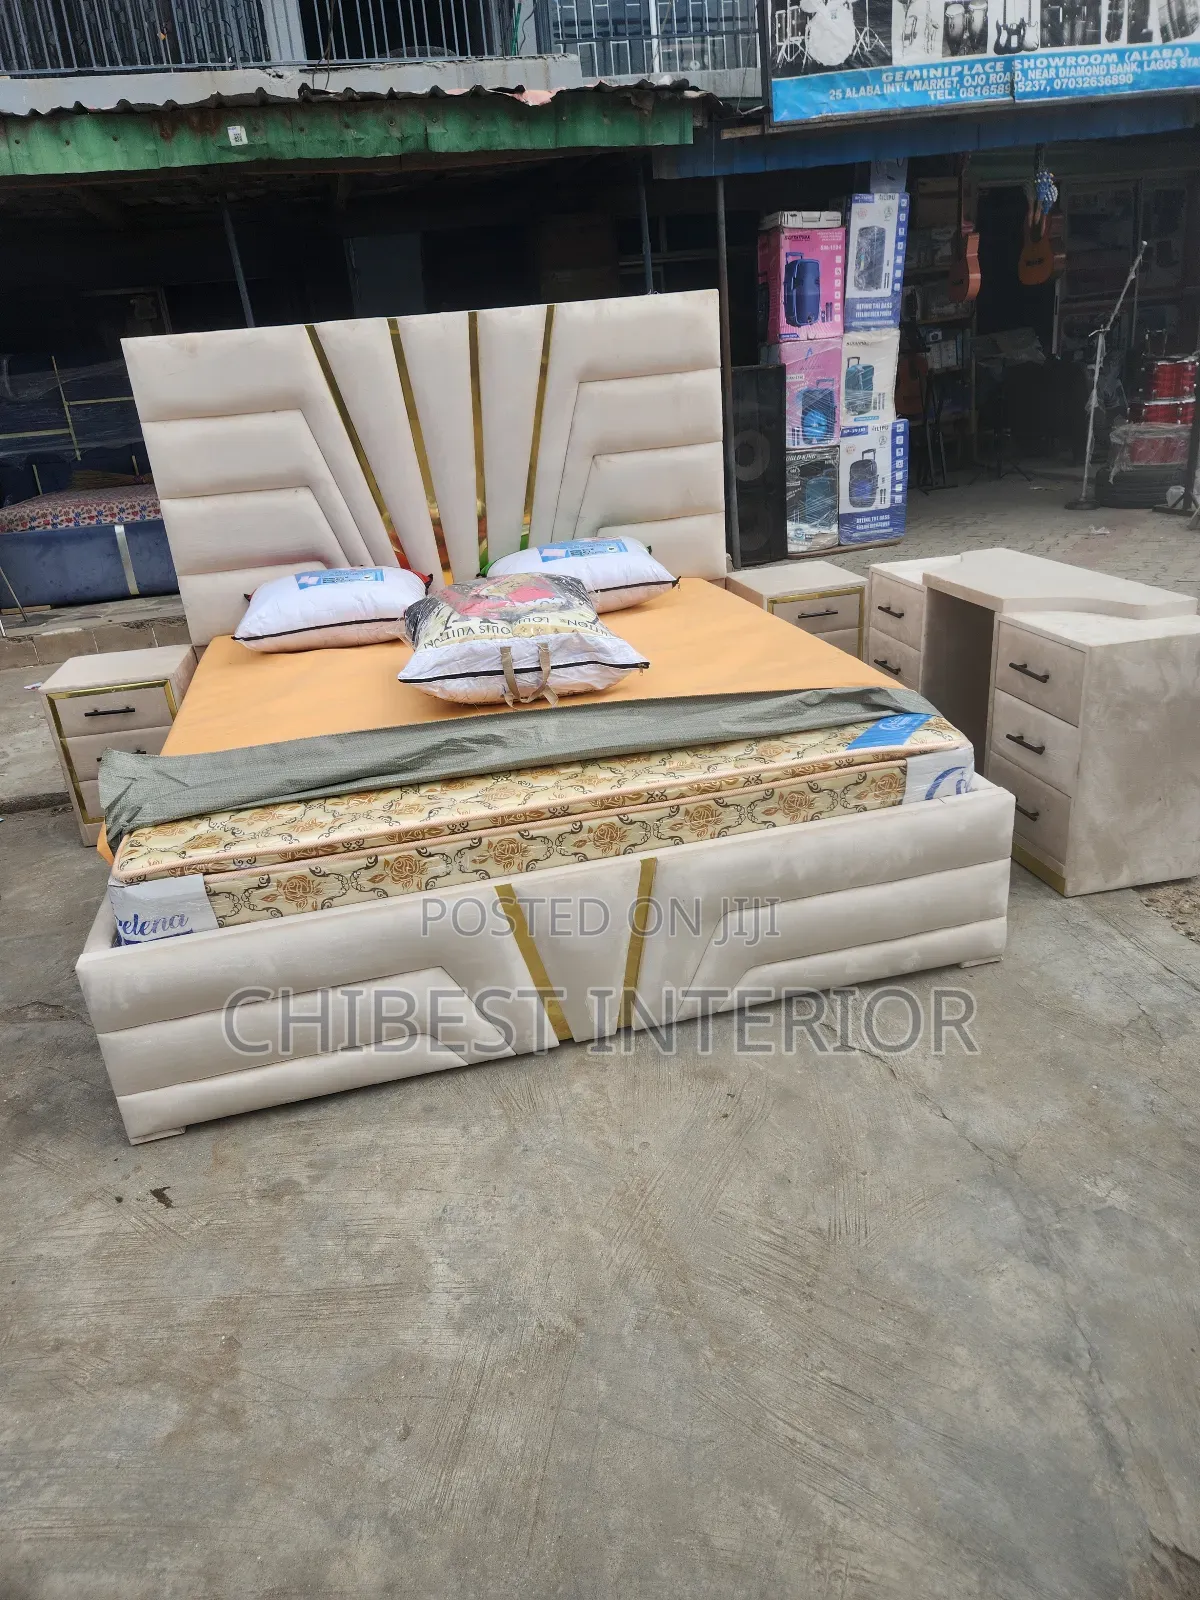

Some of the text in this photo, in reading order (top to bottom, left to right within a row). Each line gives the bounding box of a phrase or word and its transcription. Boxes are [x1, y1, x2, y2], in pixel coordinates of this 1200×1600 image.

[881, 47, 1190, 83] GEMINIPLACE SHOWROOM (ALABA)
[829, 89, 842, 101] 25
[845, 84, 881, 98] ALABA
[913, 77, 960, 91] MARKET,
[963, 74, 986, 86] OJO
[1028, 67, 1056, 80] NEAR
[1059, 64, 1107, 78] DIAMOND
[1110, 61, 1141, 75] BANK,
[1143, 58, 1178, 71] LAGOS
[1180, 56, 1200, 69] STA
[928, 89, 956, 100] TEL:
[478, 624, 511, 635] OUIS
[117, 913, 190, 936] elena
